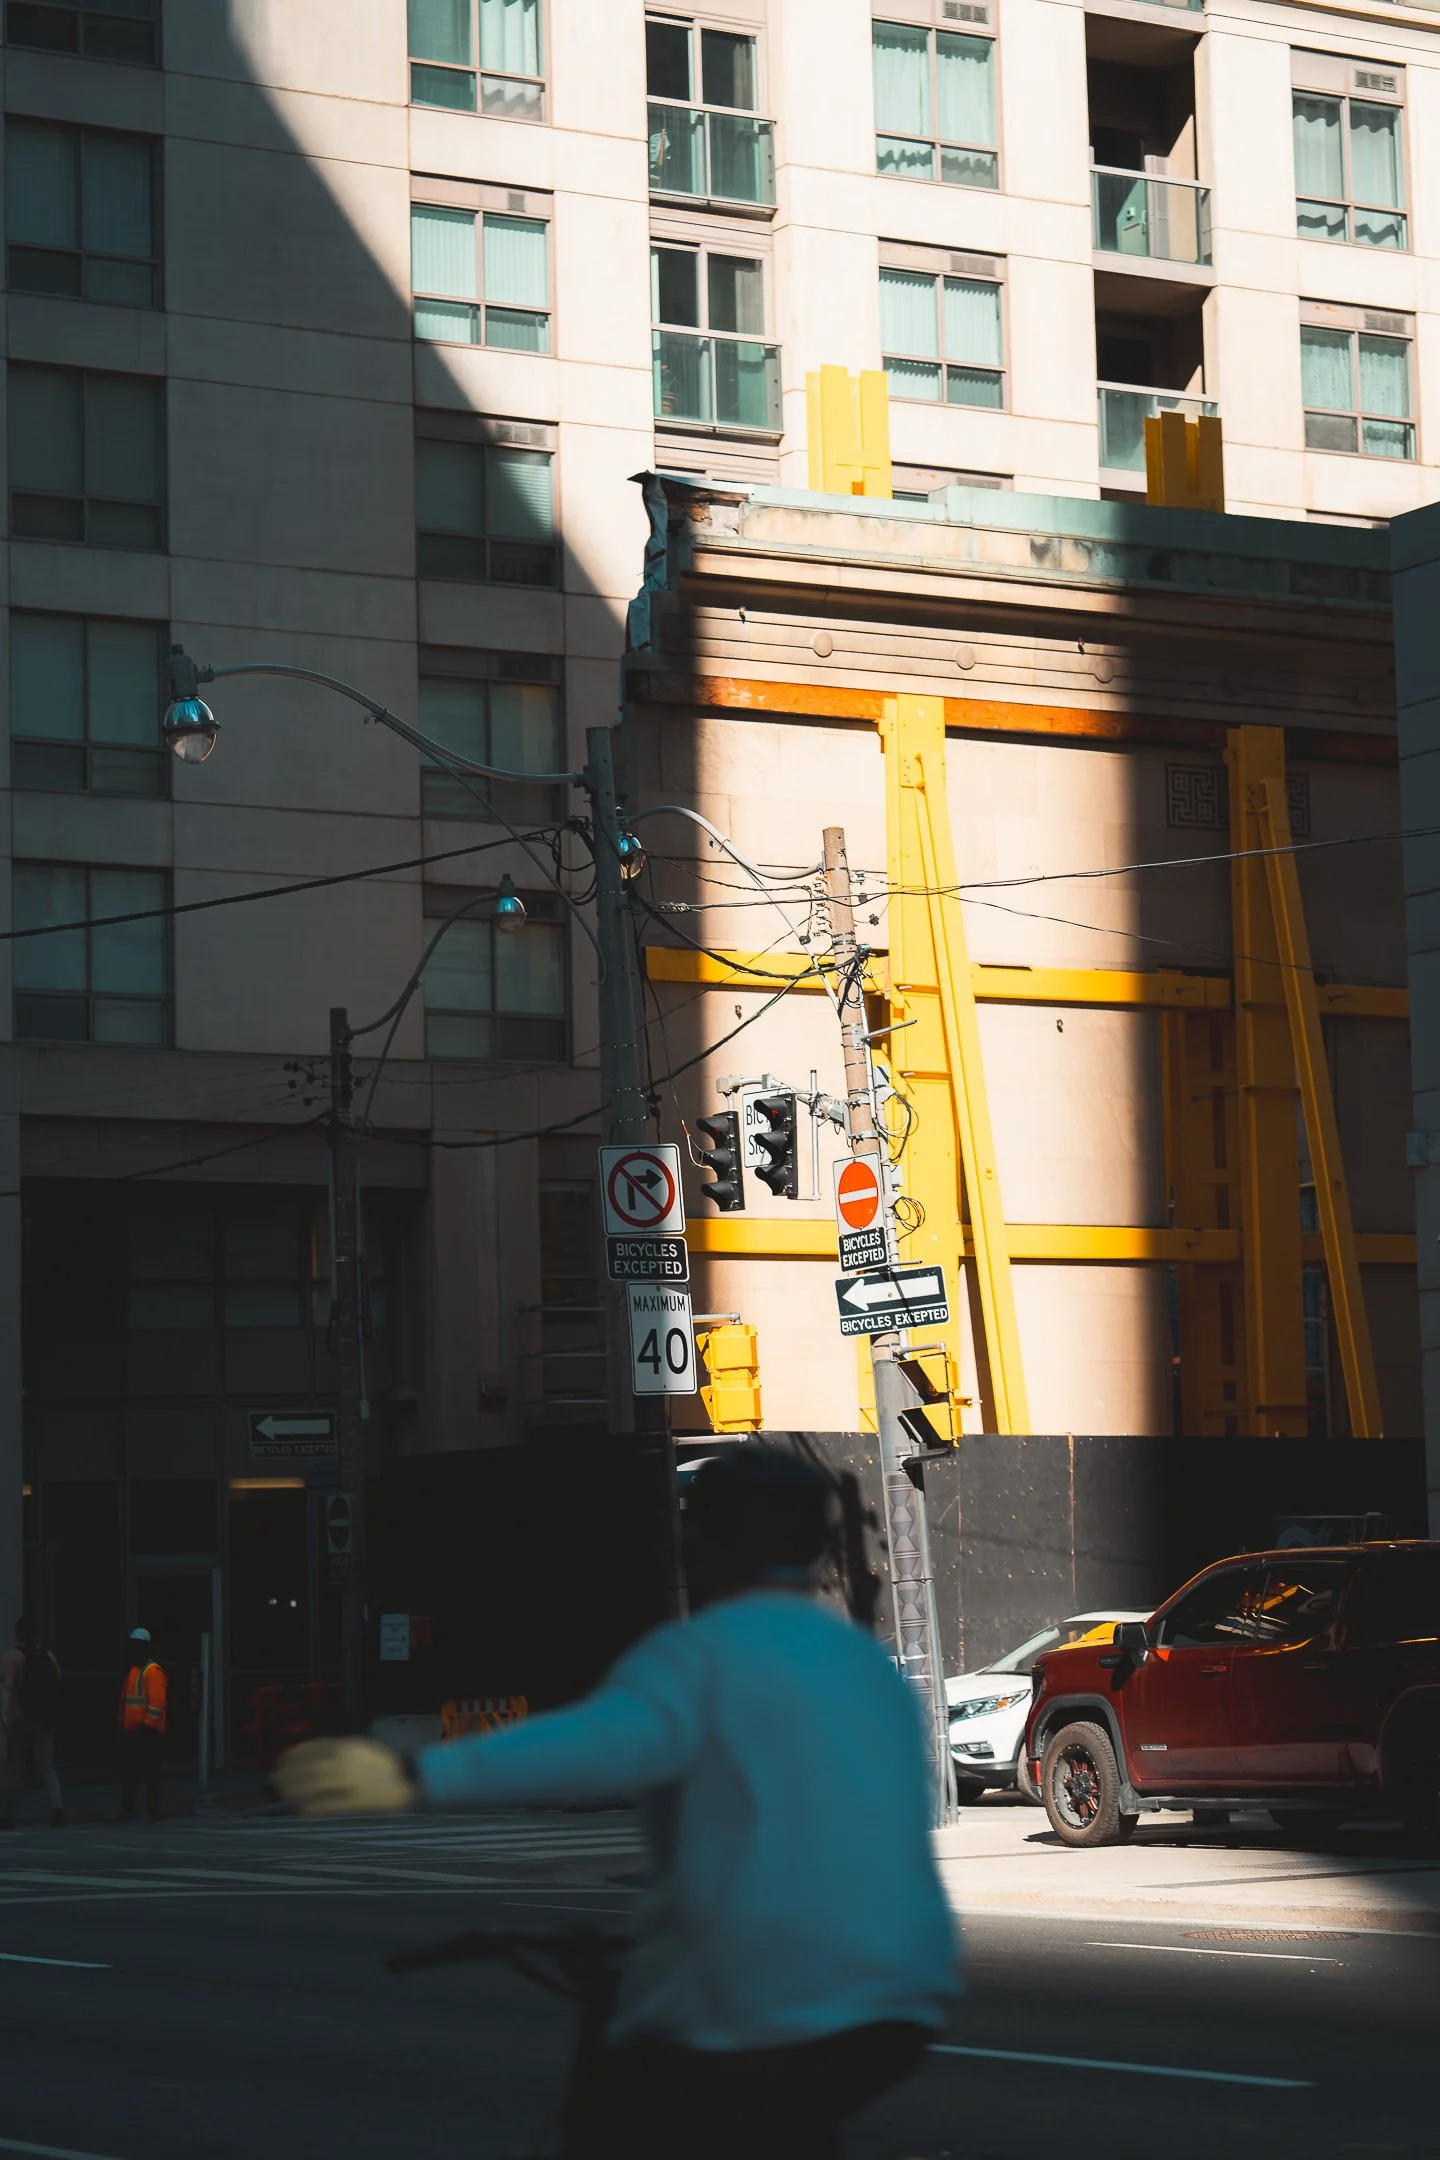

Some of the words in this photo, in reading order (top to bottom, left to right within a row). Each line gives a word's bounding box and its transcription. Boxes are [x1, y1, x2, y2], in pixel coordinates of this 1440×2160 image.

[616, 1243, 678, 1257] BICYCLES
[843, 1232, 881, 1252] BICYCLES
[842, 1248, 885, 1268] EXCEPTED
[614, 1260, 683, 1275] EXCEPTED
[633, 1295, 686, 1312] MAXIMUM
[841, 1316, 892, 1333] BICYCLES
[637, 1327, 689, 1375] 40
